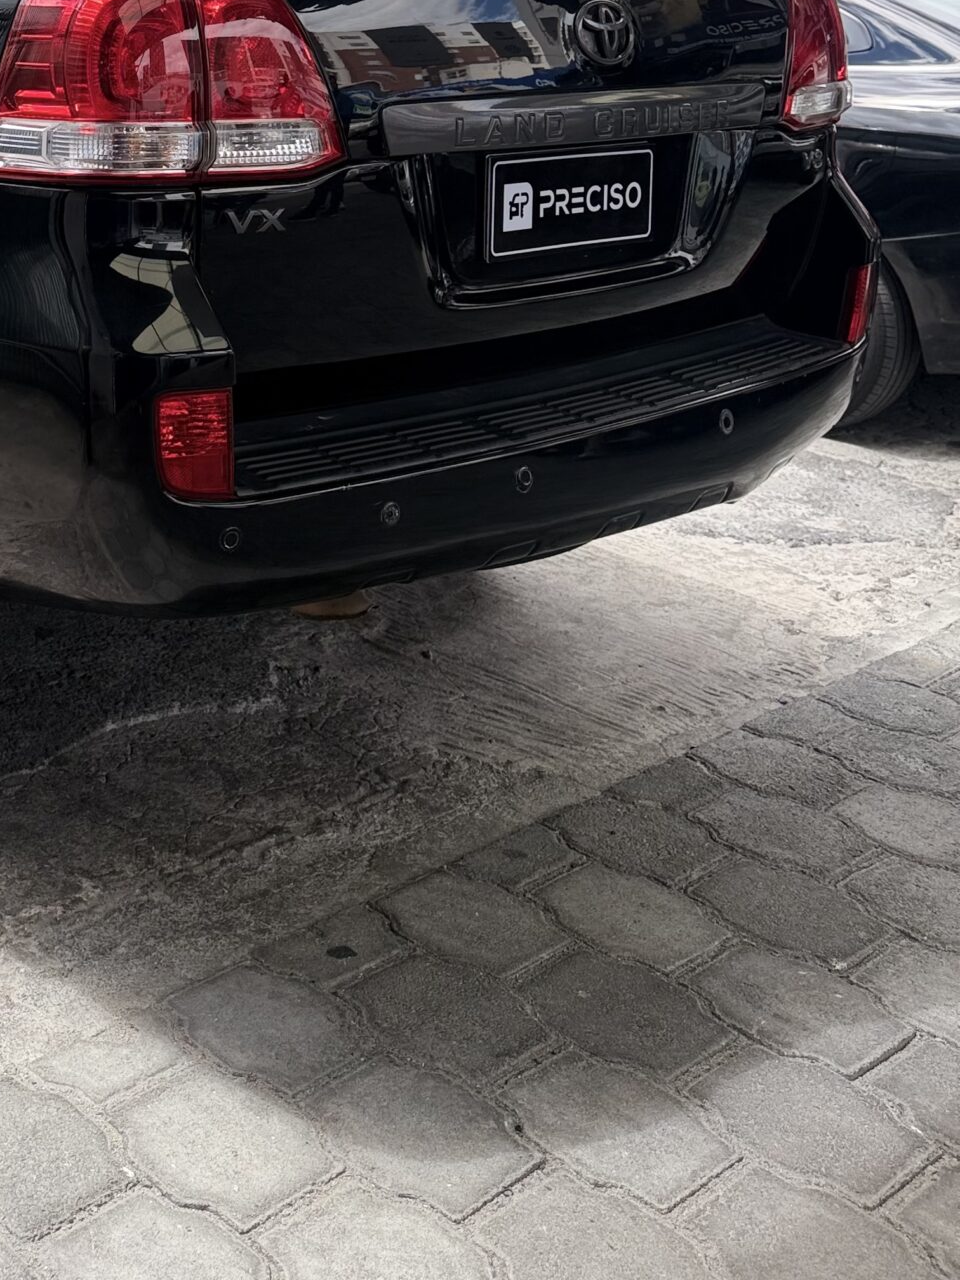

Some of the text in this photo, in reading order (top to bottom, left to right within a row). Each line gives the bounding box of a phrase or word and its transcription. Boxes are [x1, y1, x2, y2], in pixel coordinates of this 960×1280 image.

[455, 110, 566, 147] LAND
[539, 181, 642, 218] PRECISO
[224, 208, 286, 234] VX
